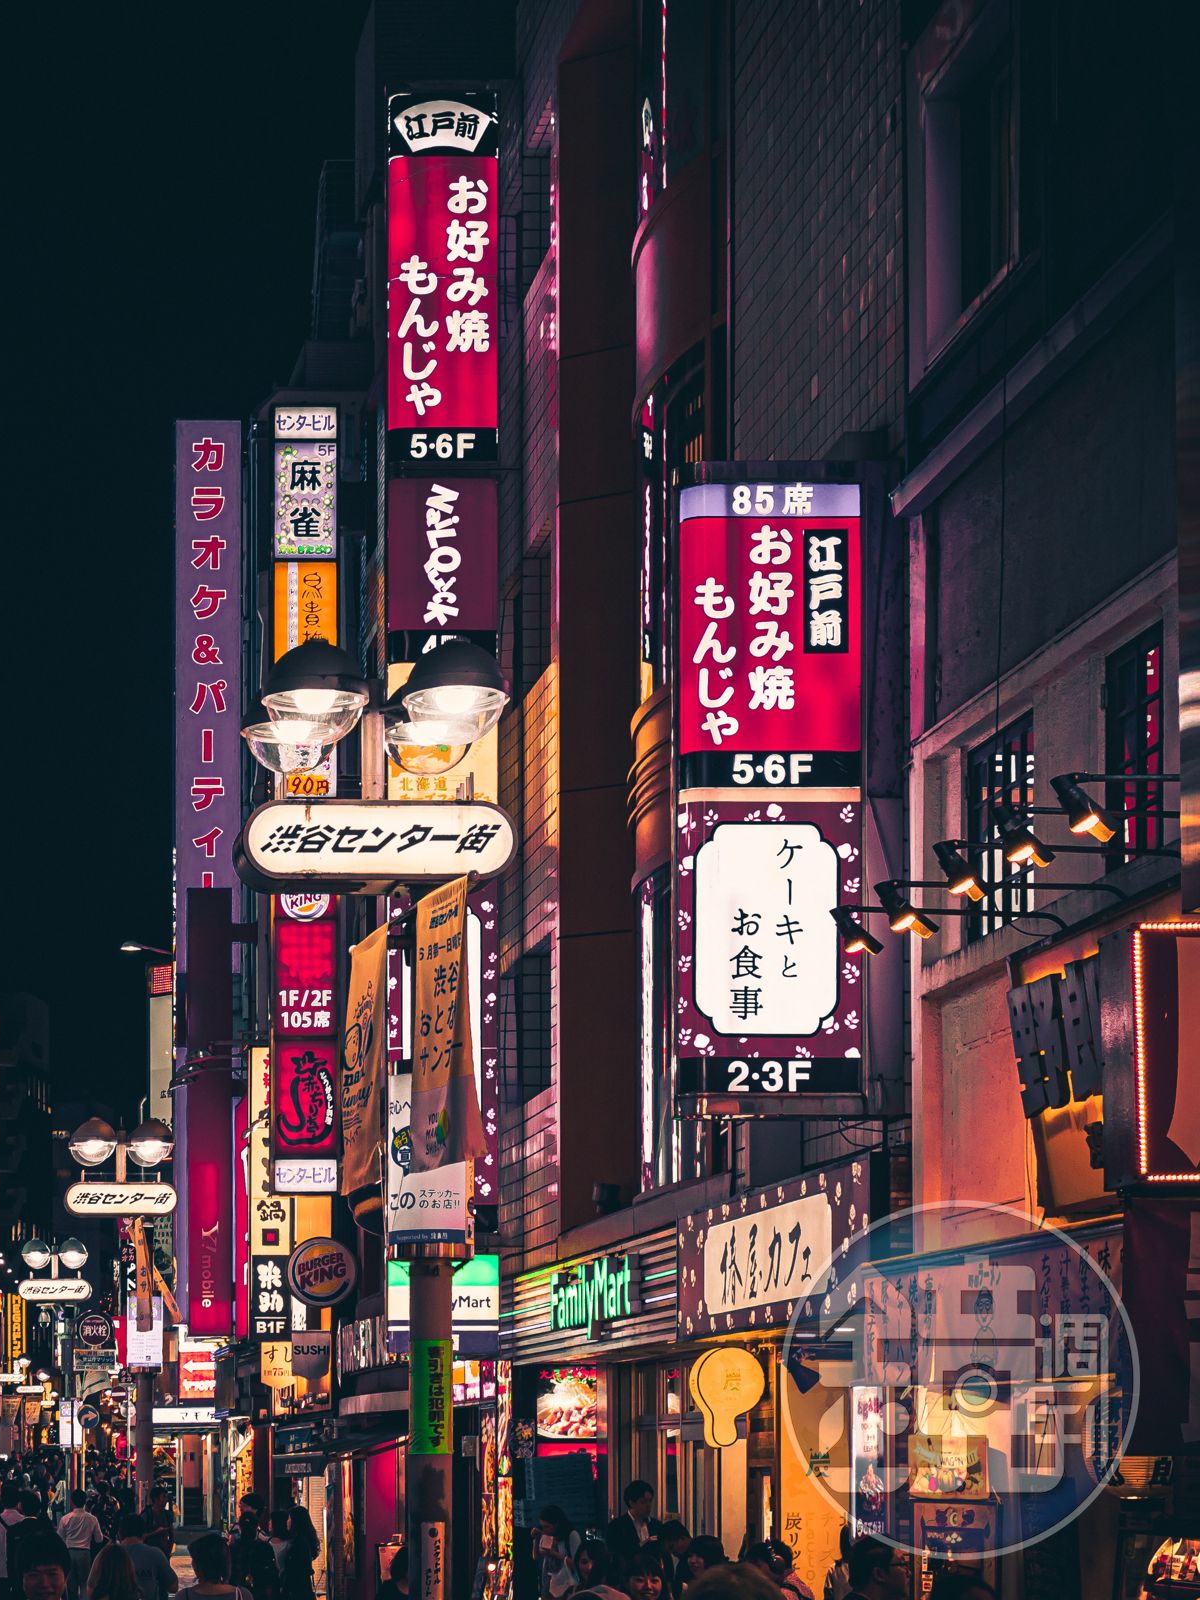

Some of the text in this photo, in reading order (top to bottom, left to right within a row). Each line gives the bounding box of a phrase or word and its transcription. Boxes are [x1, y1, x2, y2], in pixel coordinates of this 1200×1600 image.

[404, 111, 481, 141] 江戸前
[446, 175, 490, 353] お好み焼
[398, 255, 442, 416] もんじゃ
[276, 414, 335, 432] センタービル
[318, 445, 335, 456] 5F
[290, 459, 322, 538] 麻雀
[731, 483, 814, 516] 85席
[809, 536, 843, 646] 江戸前
[749, 525, 795, 711] お好み焼
[692, 577, 739, 745] もんじゃ
[400, 776, 448, 791] 北海道
[260, 824, 502, 854] 渋谷センター街
[775, 838, 804, 979] ケーキと
[729, 908, 764, 1021] お食事
[433, 960, 460, 998] 渋谷
[279, 989, 332, 1007] 1F/2F
[281, 1011, 331, 1028] 105席
[276, 1167, 336, 1185] センタービル
[72, 1192, 173, 1205] 渋谷センター街
[390, 1192, 416, 1211] この
[419, 1189, 460, 1198] ステッカー
[256, 1200, 286, 1223] 鍋
[297, 1252, 344, 1276] BURGER
[300, 1262, 347, 1290] KING
[719, 1221, 812, 1307] 椿屋カフェ
[23, 1286, 86, 1295] 渋谷センター街
[550, 1254, 632, 1340] FamilyMart
[83, 1325, 108, 1337] 消火栓
[256, 1321, 286, 1334] B1F
[294, 1345, 330, 1356] SUSHI
